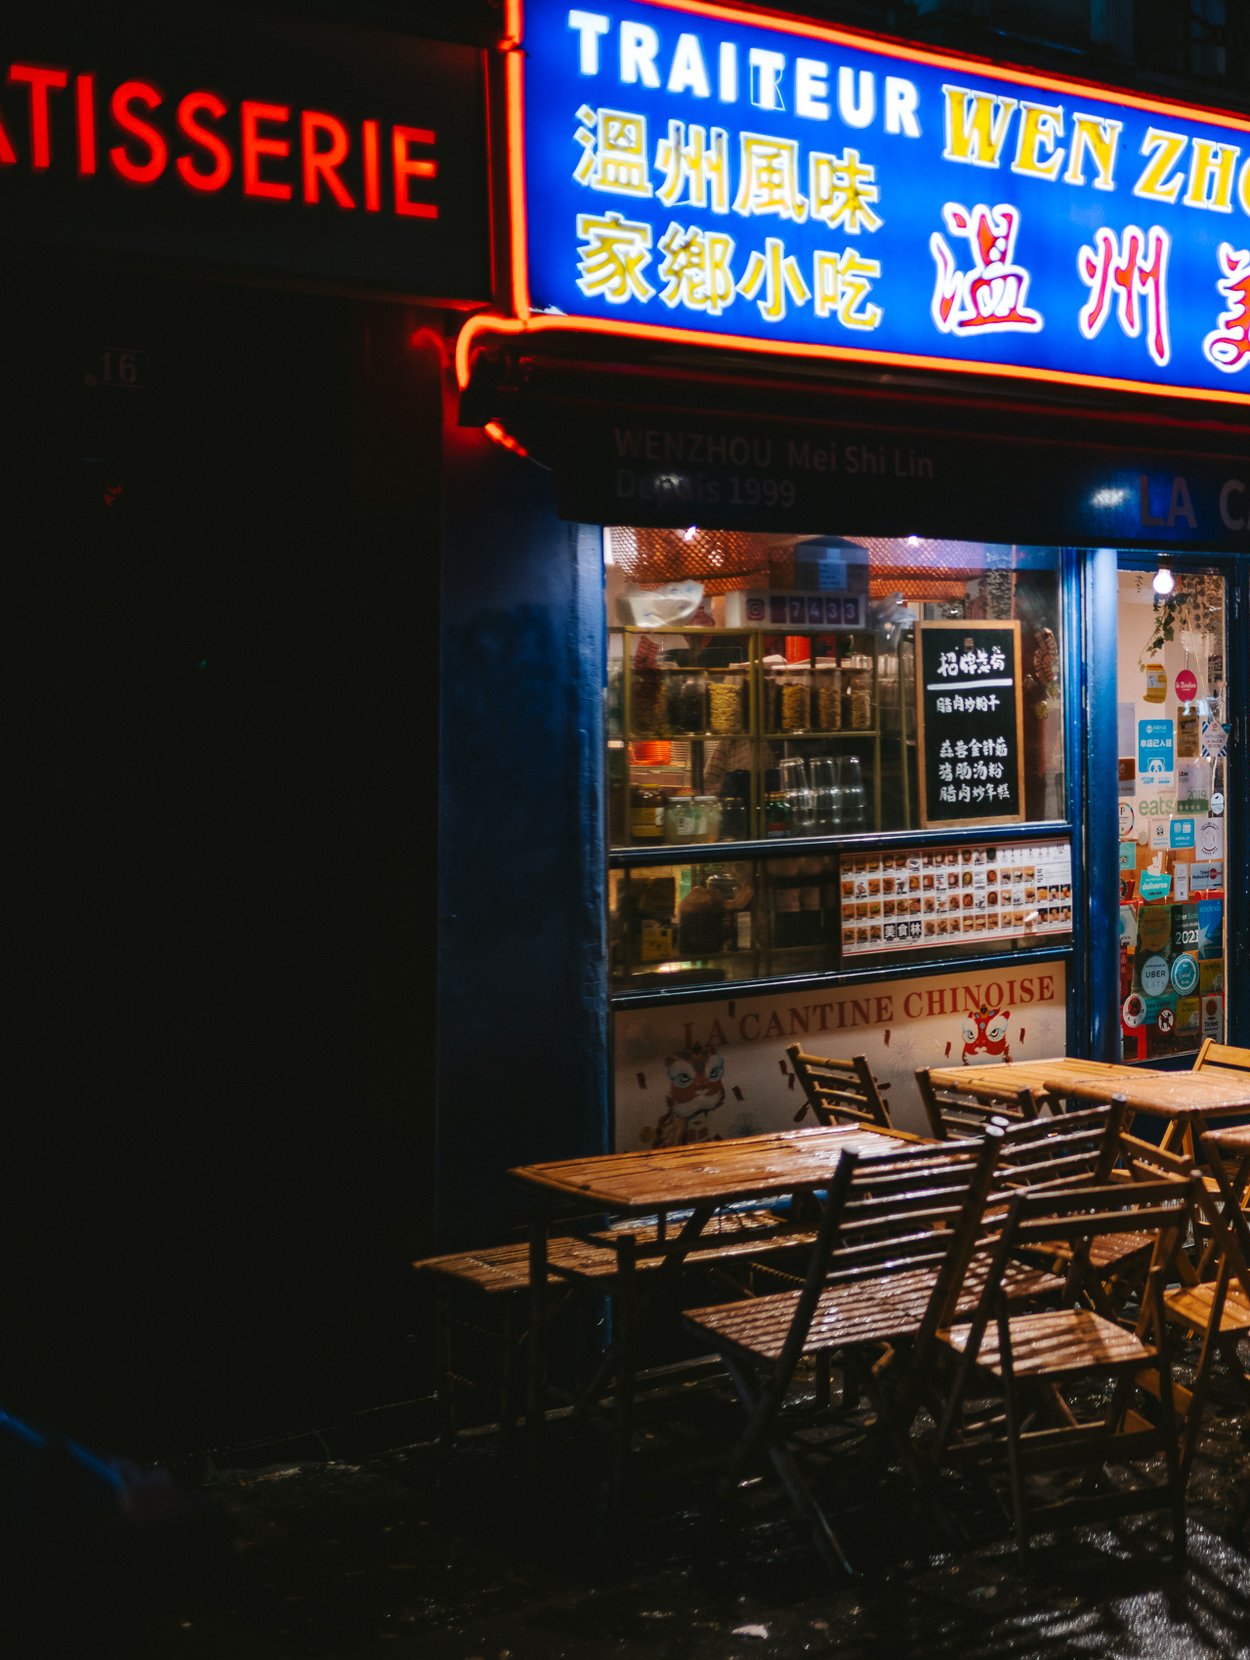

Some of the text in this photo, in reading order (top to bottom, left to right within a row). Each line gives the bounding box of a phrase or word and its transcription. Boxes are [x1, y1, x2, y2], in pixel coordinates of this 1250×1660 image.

[568, 9, 921, 138] TRAITEUR
[0, 64, 438, 219] TISSERIE
[942, 83, 1123, 191] WEN
[576, 211, 882, 330] 家鄉小吃
[613, 426, 934, 478] WENZHOU Mei Shi Lin
[729, 477, 796, 506] 1999
[1137, 475, 1198, 529] LA
[682, 974, 1055, 1048] LA CANTINE CHINOISE
[1145, 970, 1166, 978] UBER
